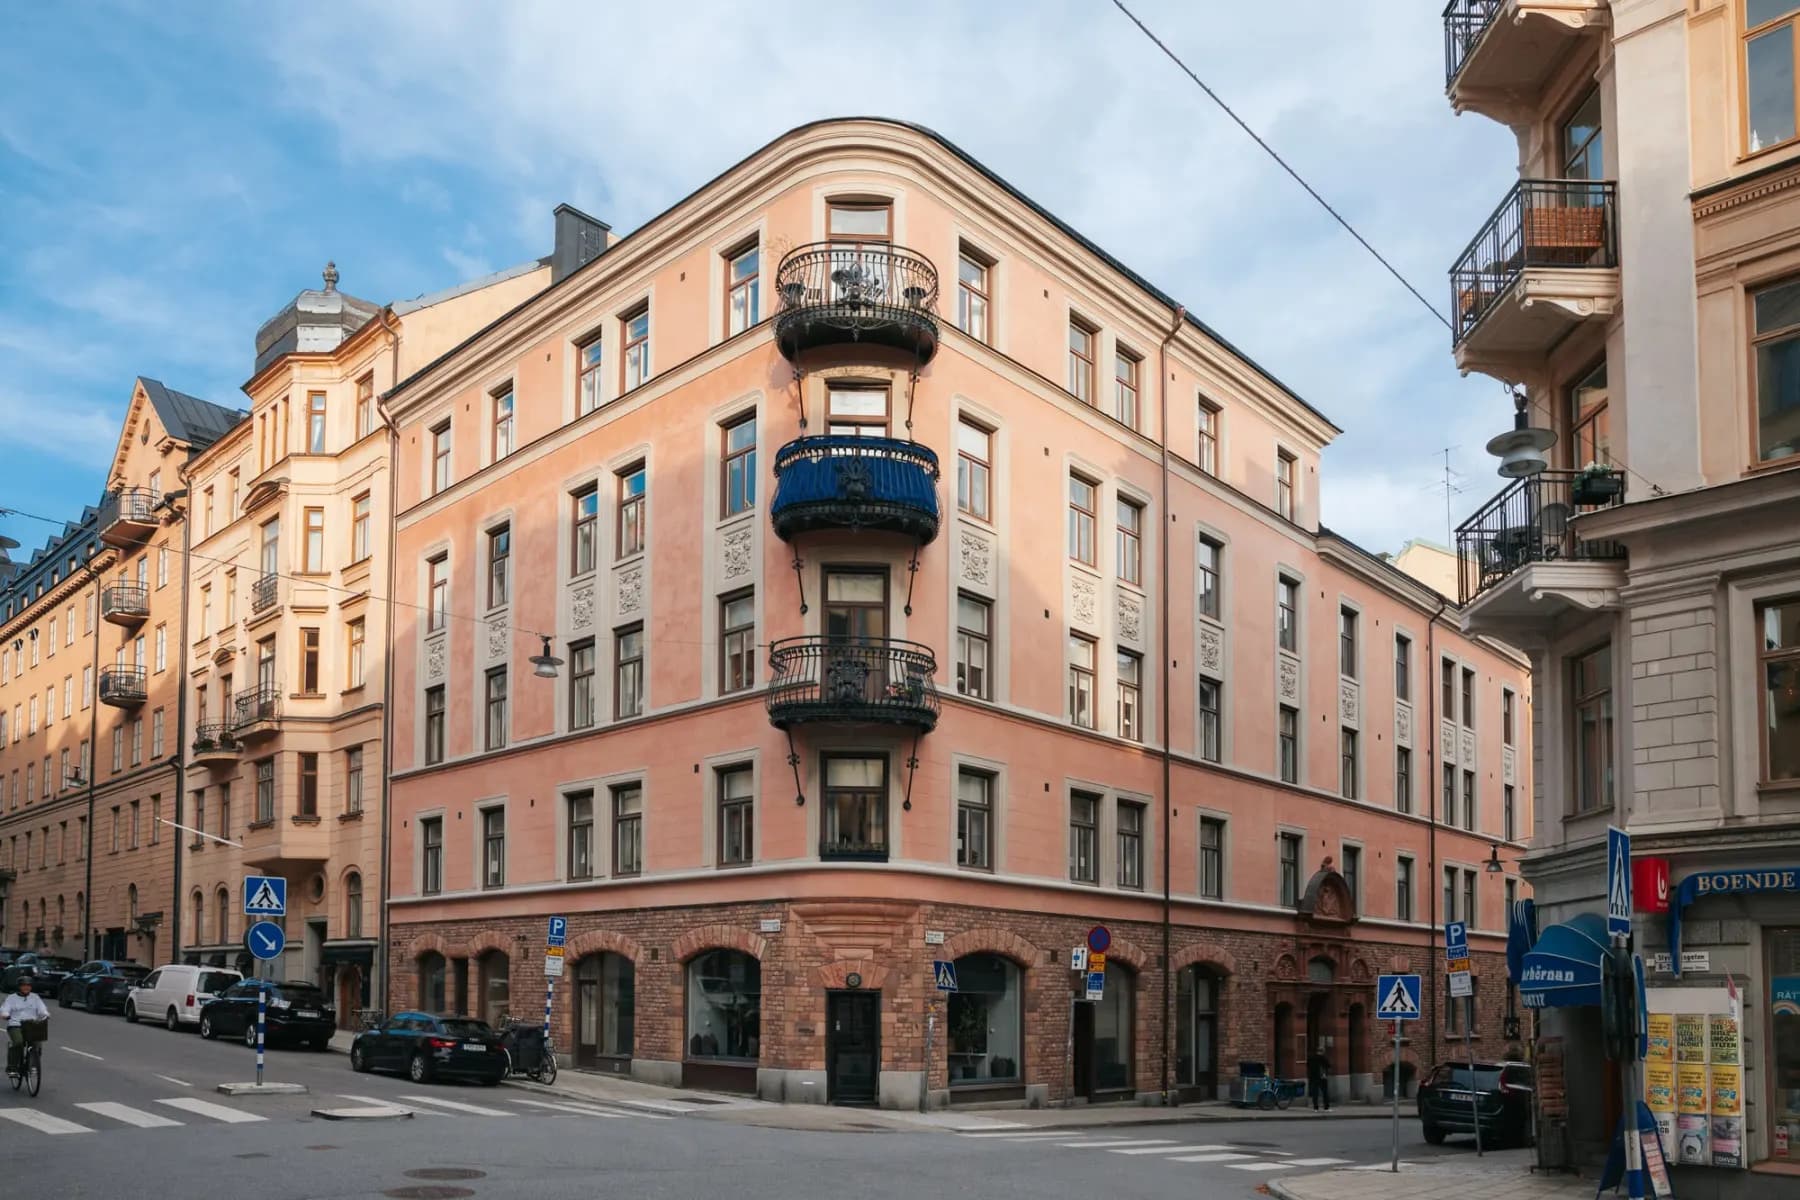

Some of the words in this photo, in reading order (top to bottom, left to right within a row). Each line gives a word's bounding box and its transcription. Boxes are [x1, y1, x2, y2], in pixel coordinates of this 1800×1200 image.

[1697, 871, 1796, 891] BOENDE
[553, 919, 564, 935] P
[1450, 924, 1462, 945] P
